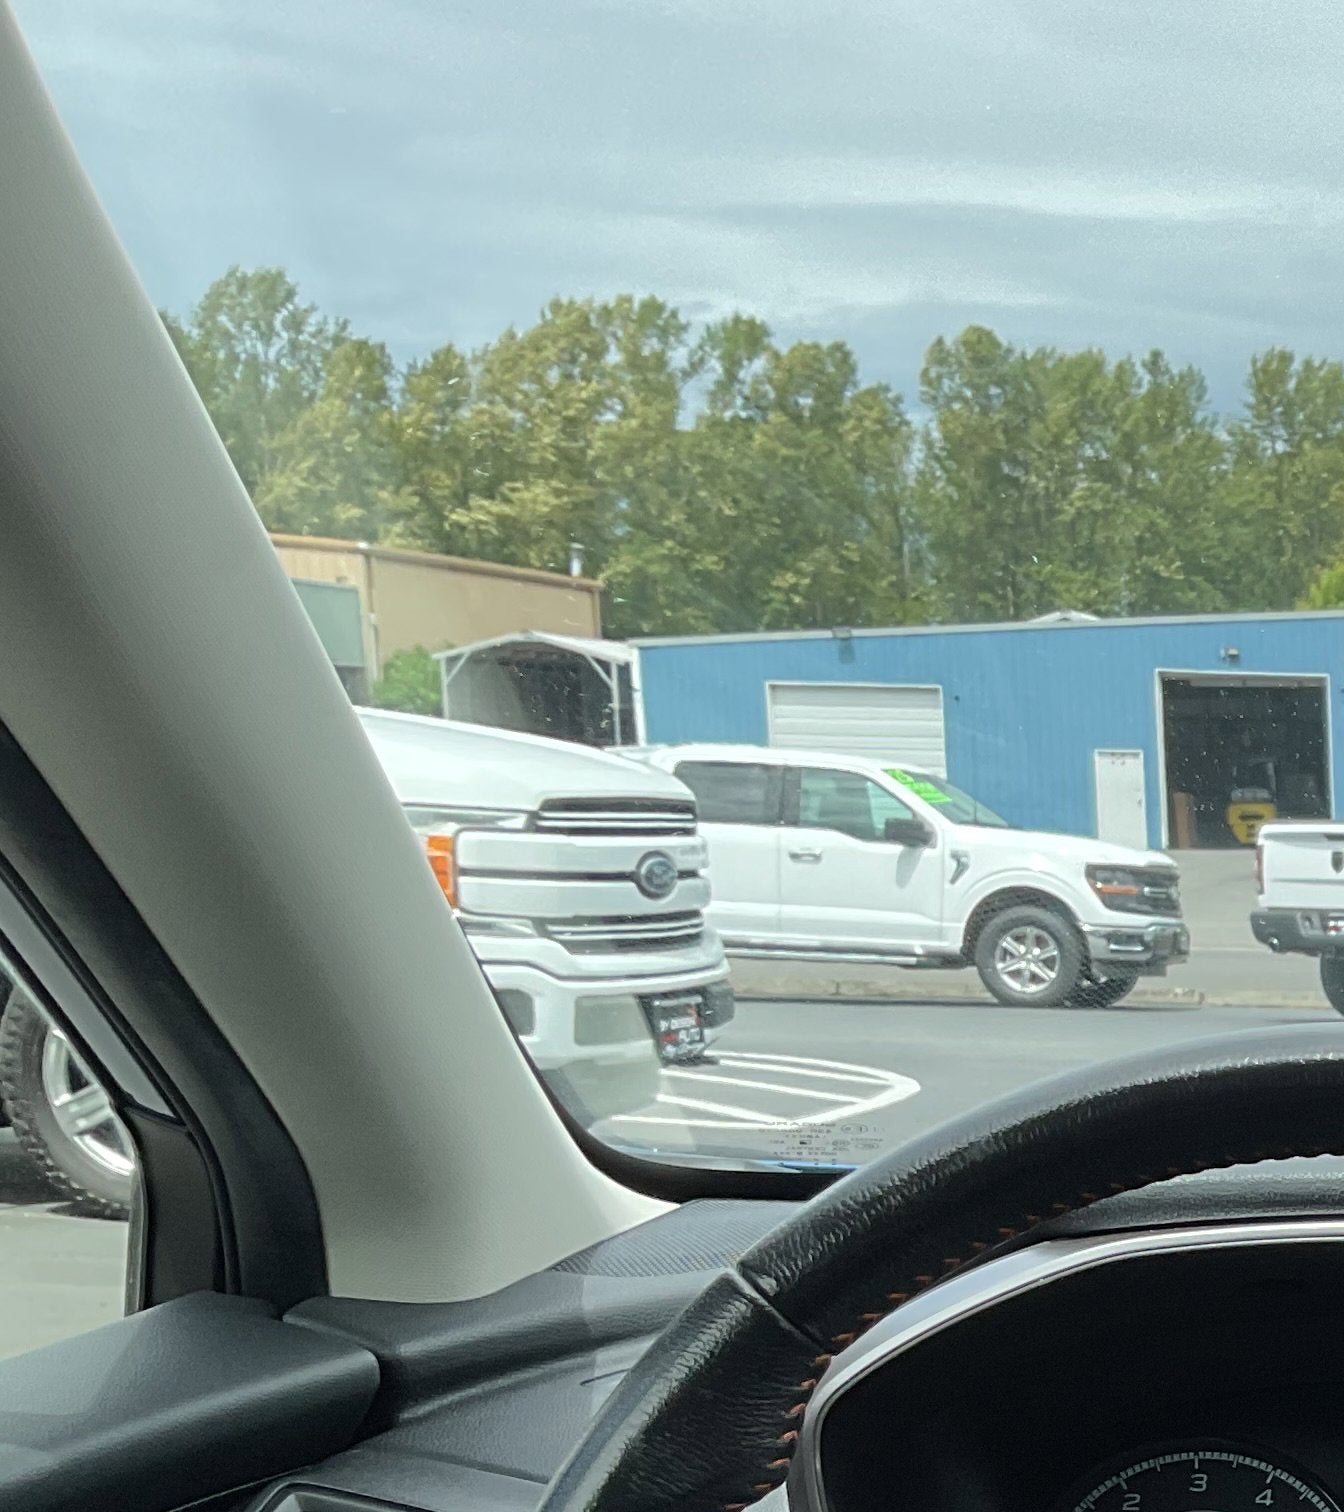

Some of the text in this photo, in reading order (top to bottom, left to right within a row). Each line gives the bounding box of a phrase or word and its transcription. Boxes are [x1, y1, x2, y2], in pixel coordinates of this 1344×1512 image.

[1189, 1473, 1208, 1492] 3
[1121, 1493, 1141, 1512] 2
[1254, 1488, 1274, 1507] 4
